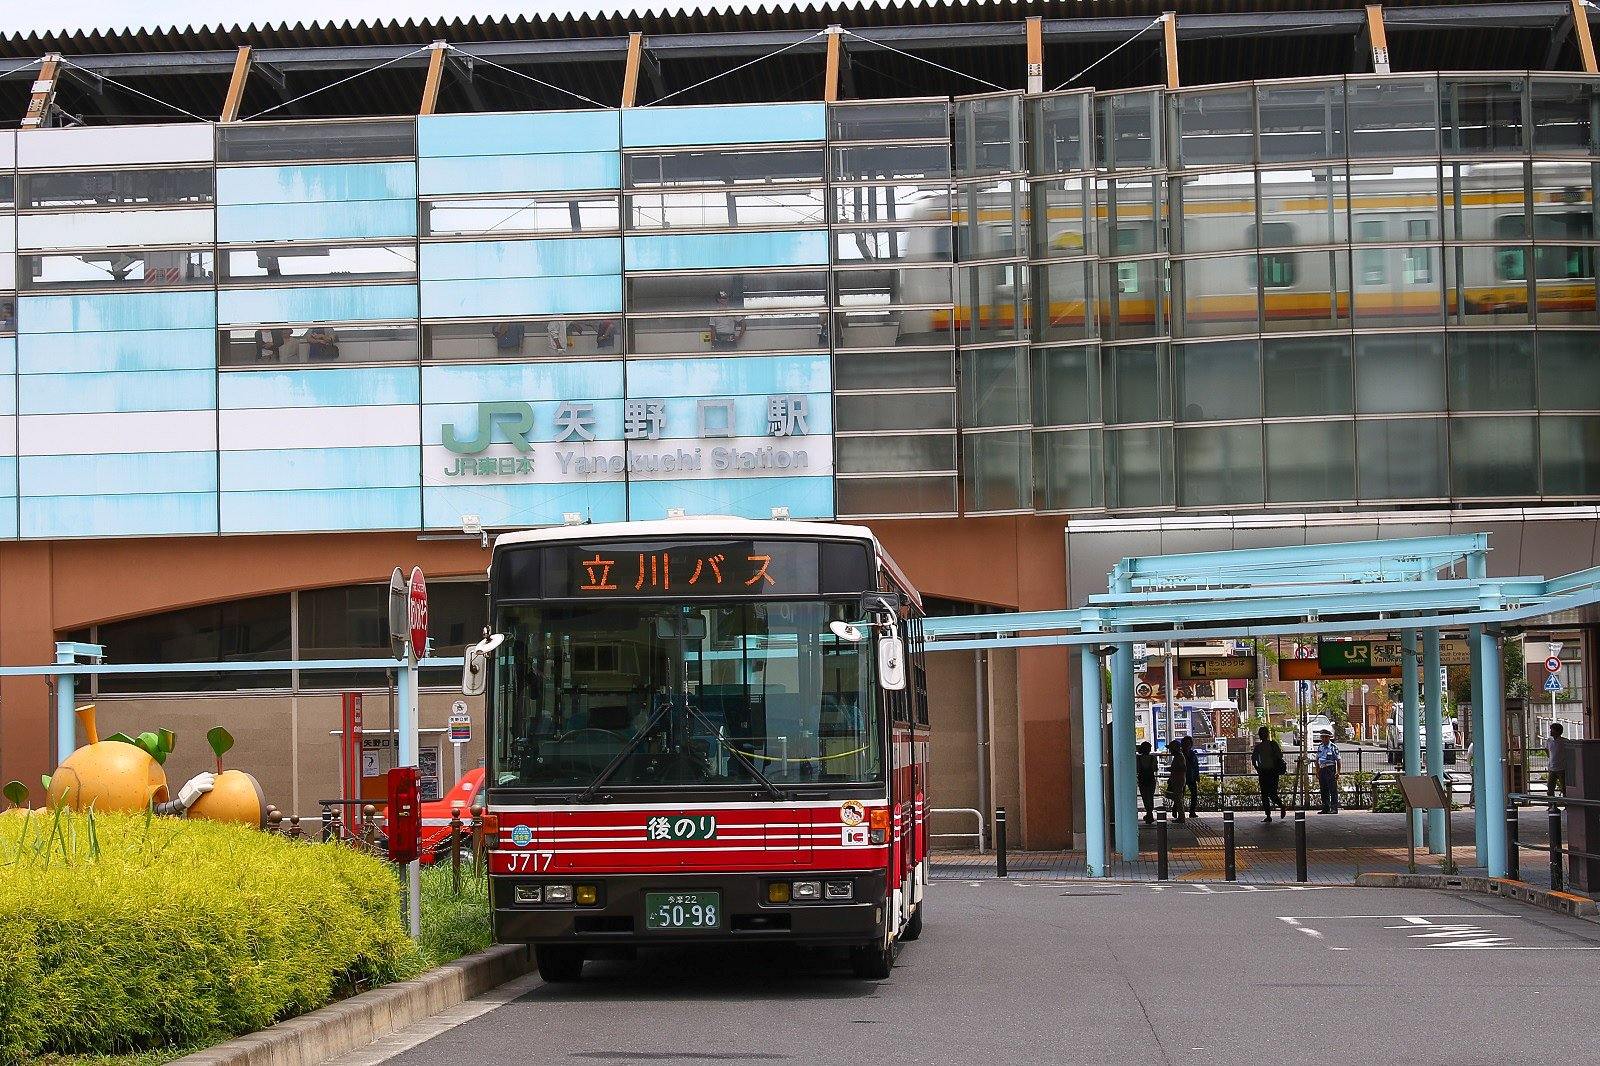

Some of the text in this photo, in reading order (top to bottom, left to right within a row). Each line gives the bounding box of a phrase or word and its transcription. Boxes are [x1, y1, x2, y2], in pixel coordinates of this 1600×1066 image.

[441, 402, 535, 454] JR
[553, 395, 810, 443] 矢野口駅
[444, 456, 535, 476] JR東日本
[555, 446, 809, 475] Yanokuchi Station
[581, 553, 776, 590] 立川バス
[1344, 645, 1368, 659] JR
[648, 816, 716, 840] 後のり
[507, 853, 553, 872] J717
[659, 904, 716, 927] 50-98
